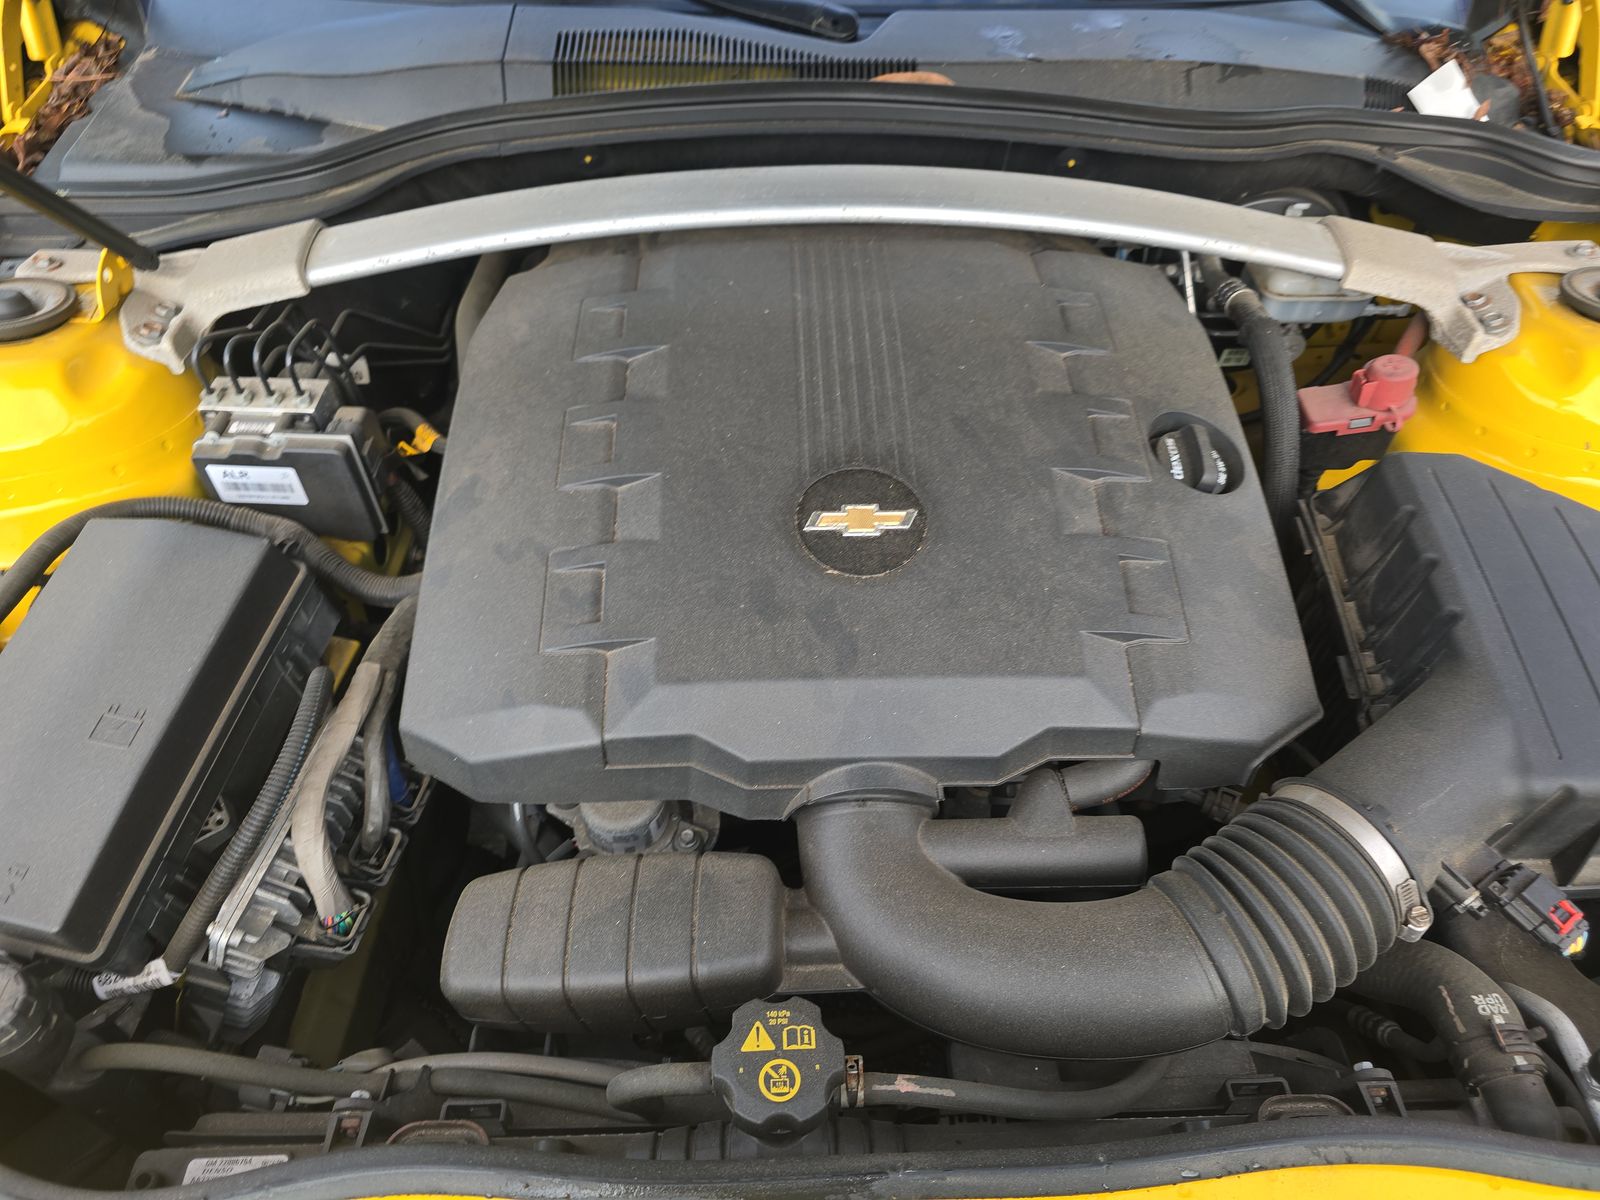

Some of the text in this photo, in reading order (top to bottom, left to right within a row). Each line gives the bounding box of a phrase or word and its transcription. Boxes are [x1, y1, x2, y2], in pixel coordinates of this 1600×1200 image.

[1165, 438, 1184, 479] dexos
[766, 1009, 791, 1018] 140 kPa
[768, 1017, 789, 1026] 20 PSI
